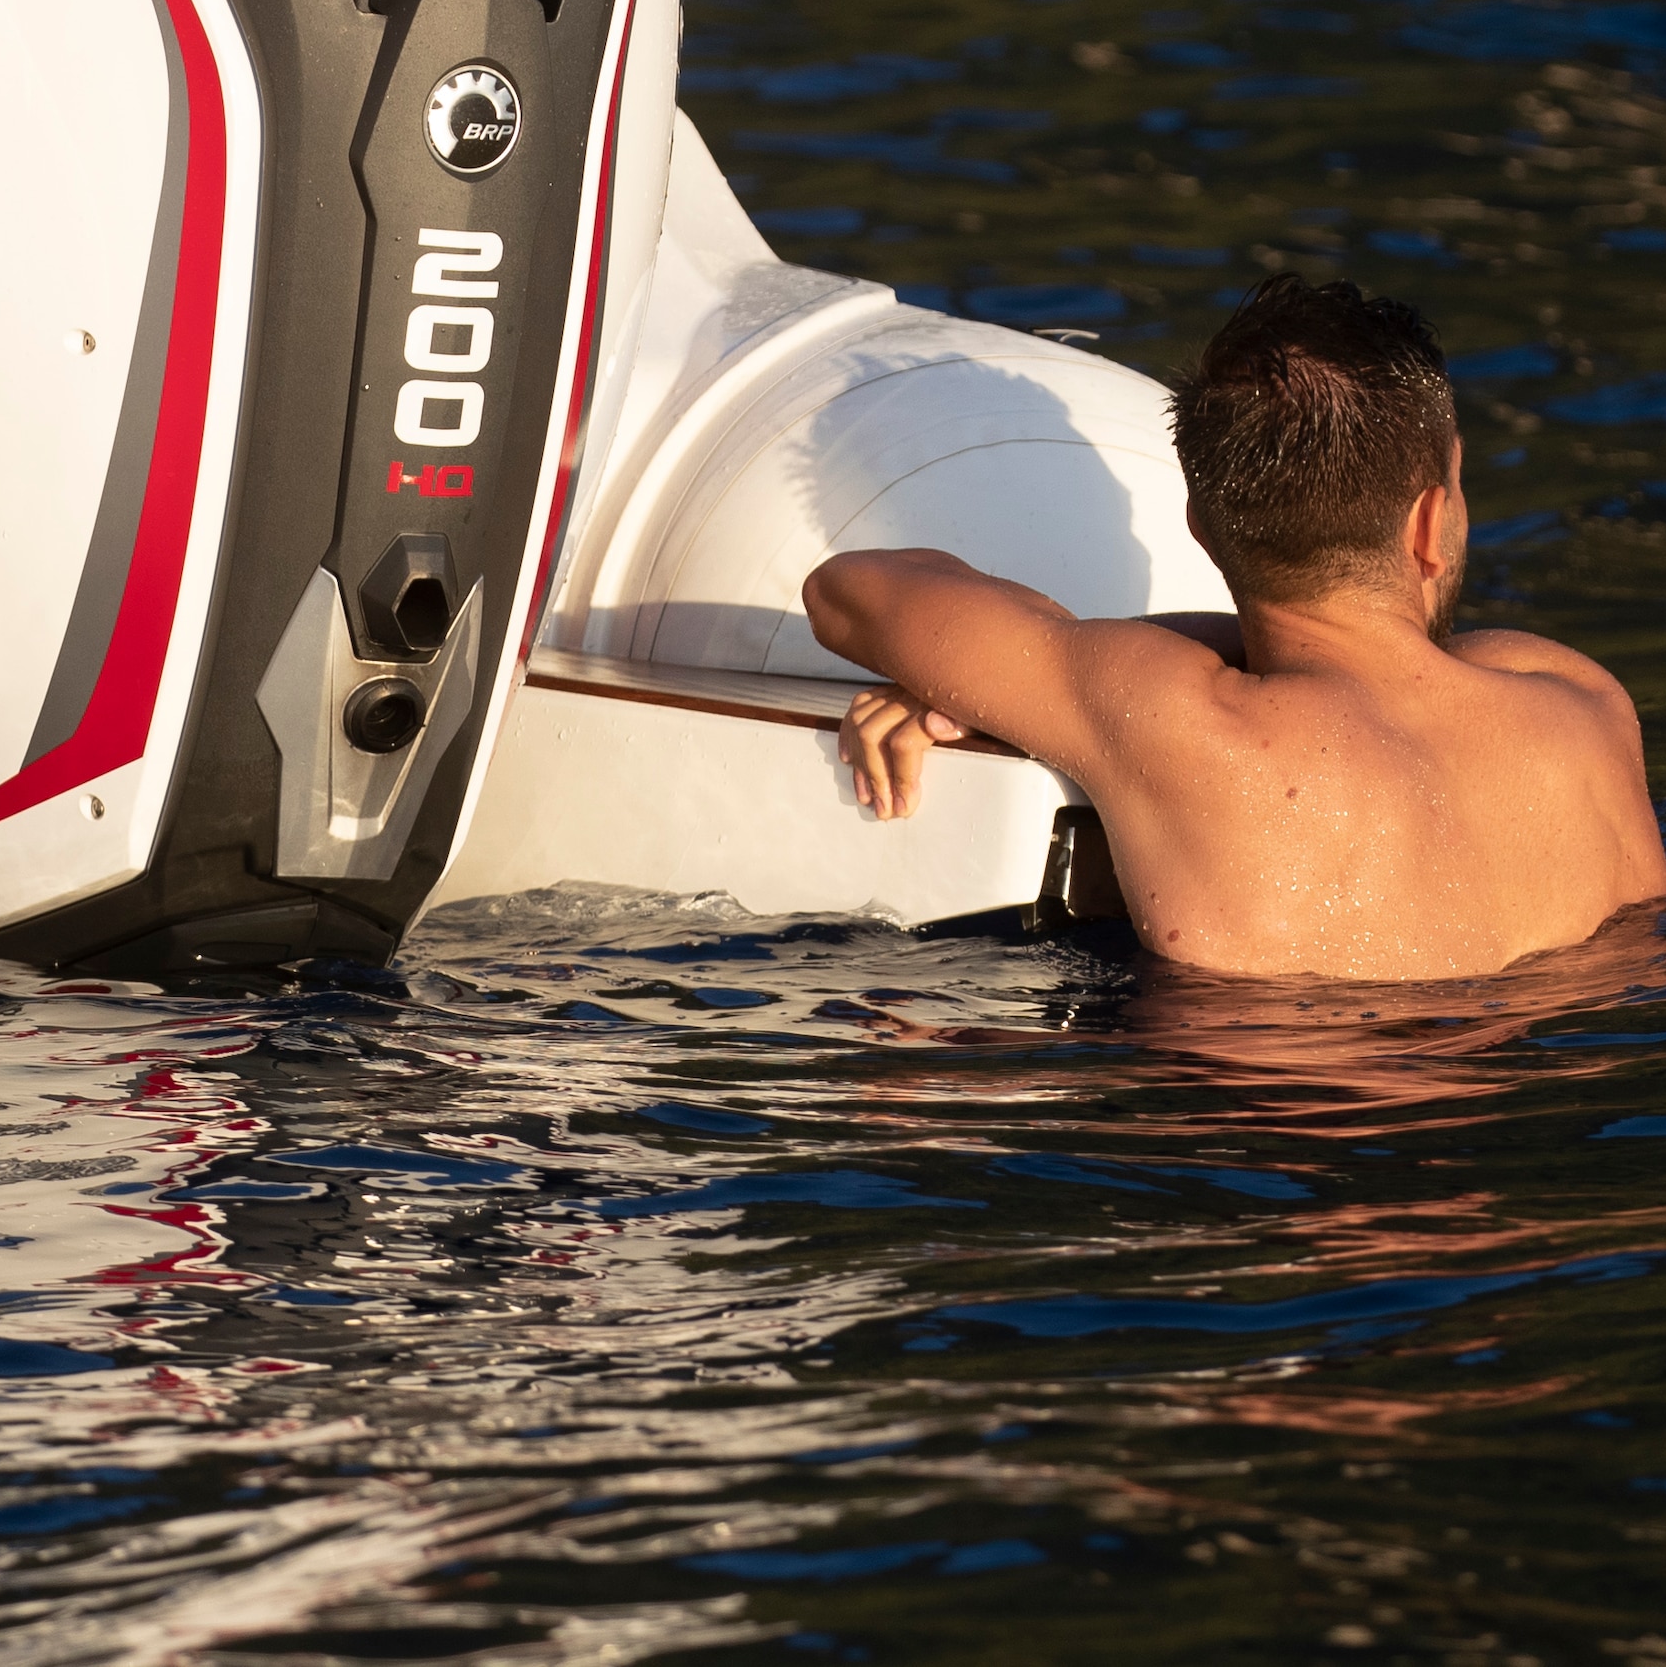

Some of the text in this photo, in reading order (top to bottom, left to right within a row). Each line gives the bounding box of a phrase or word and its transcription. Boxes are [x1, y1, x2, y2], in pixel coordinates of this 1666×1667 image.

[462, 122, 514, 141] BRP
[393, 227, 504, 448] 200
[386, 461, 474, 497] HO
